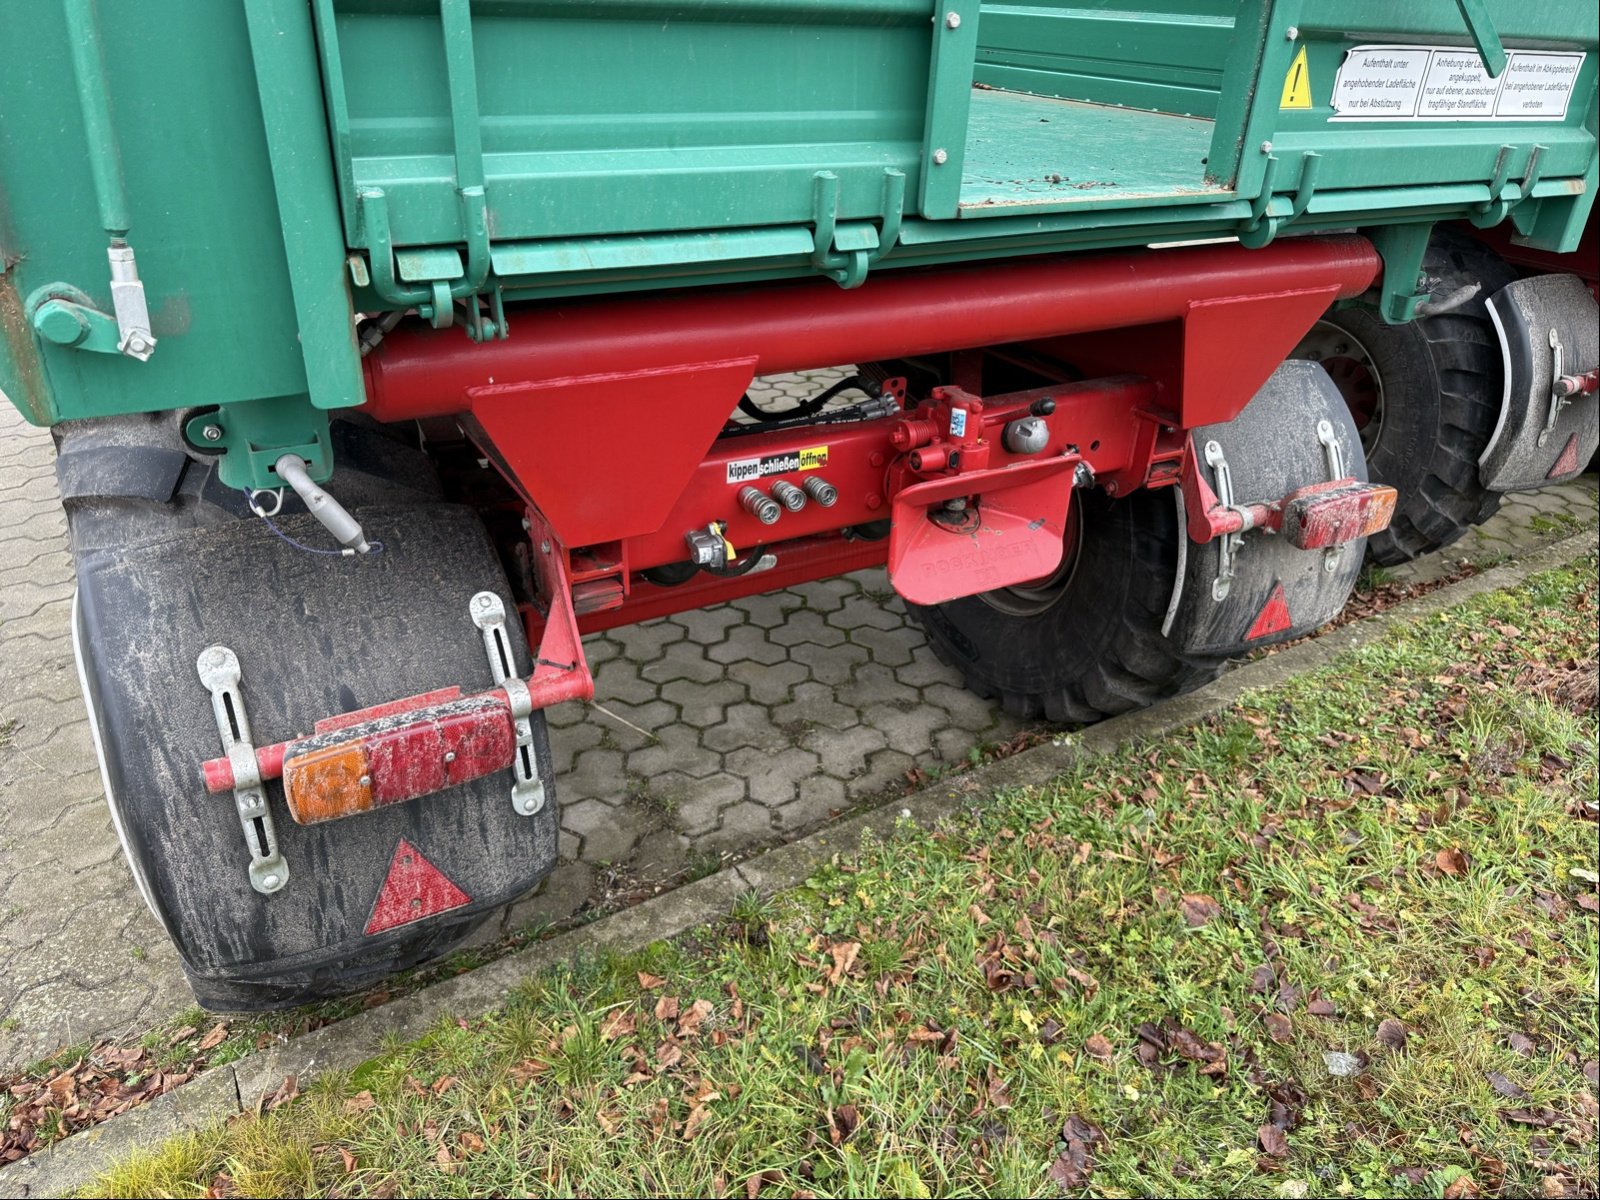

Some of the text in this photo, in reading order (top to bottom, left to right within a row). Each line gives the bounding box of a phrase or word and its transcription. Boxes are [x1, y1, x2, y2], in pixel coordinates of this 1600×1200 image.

[1362, 58, 1409, 69] Aufenthalt unter
[1436, 58, 1464, 70] Anhebung
[1464, 59, 1474, 68] der
[1511, 63, 1575, 75] Aufenthalt im Abkippbereich
[1386, 79, 1416, 89] Ladefläche
[1505, 82, 1570, 93] bei angehobener Ladefläche
[1426, 87, 1436, 95] nur
[1436, 85, 1446, 94] auf
[1465, 86, 1497, 95] ausreichend
[1348, 98, 1402, 110] nur bei Abstützung
[1428, 99, 1487, 111] tragfähiger Standfläche
[1522, 100, 1543, 108] verboten
[728, 463, 758, 479] kippen
[760, 456, 799, 475] schließen
